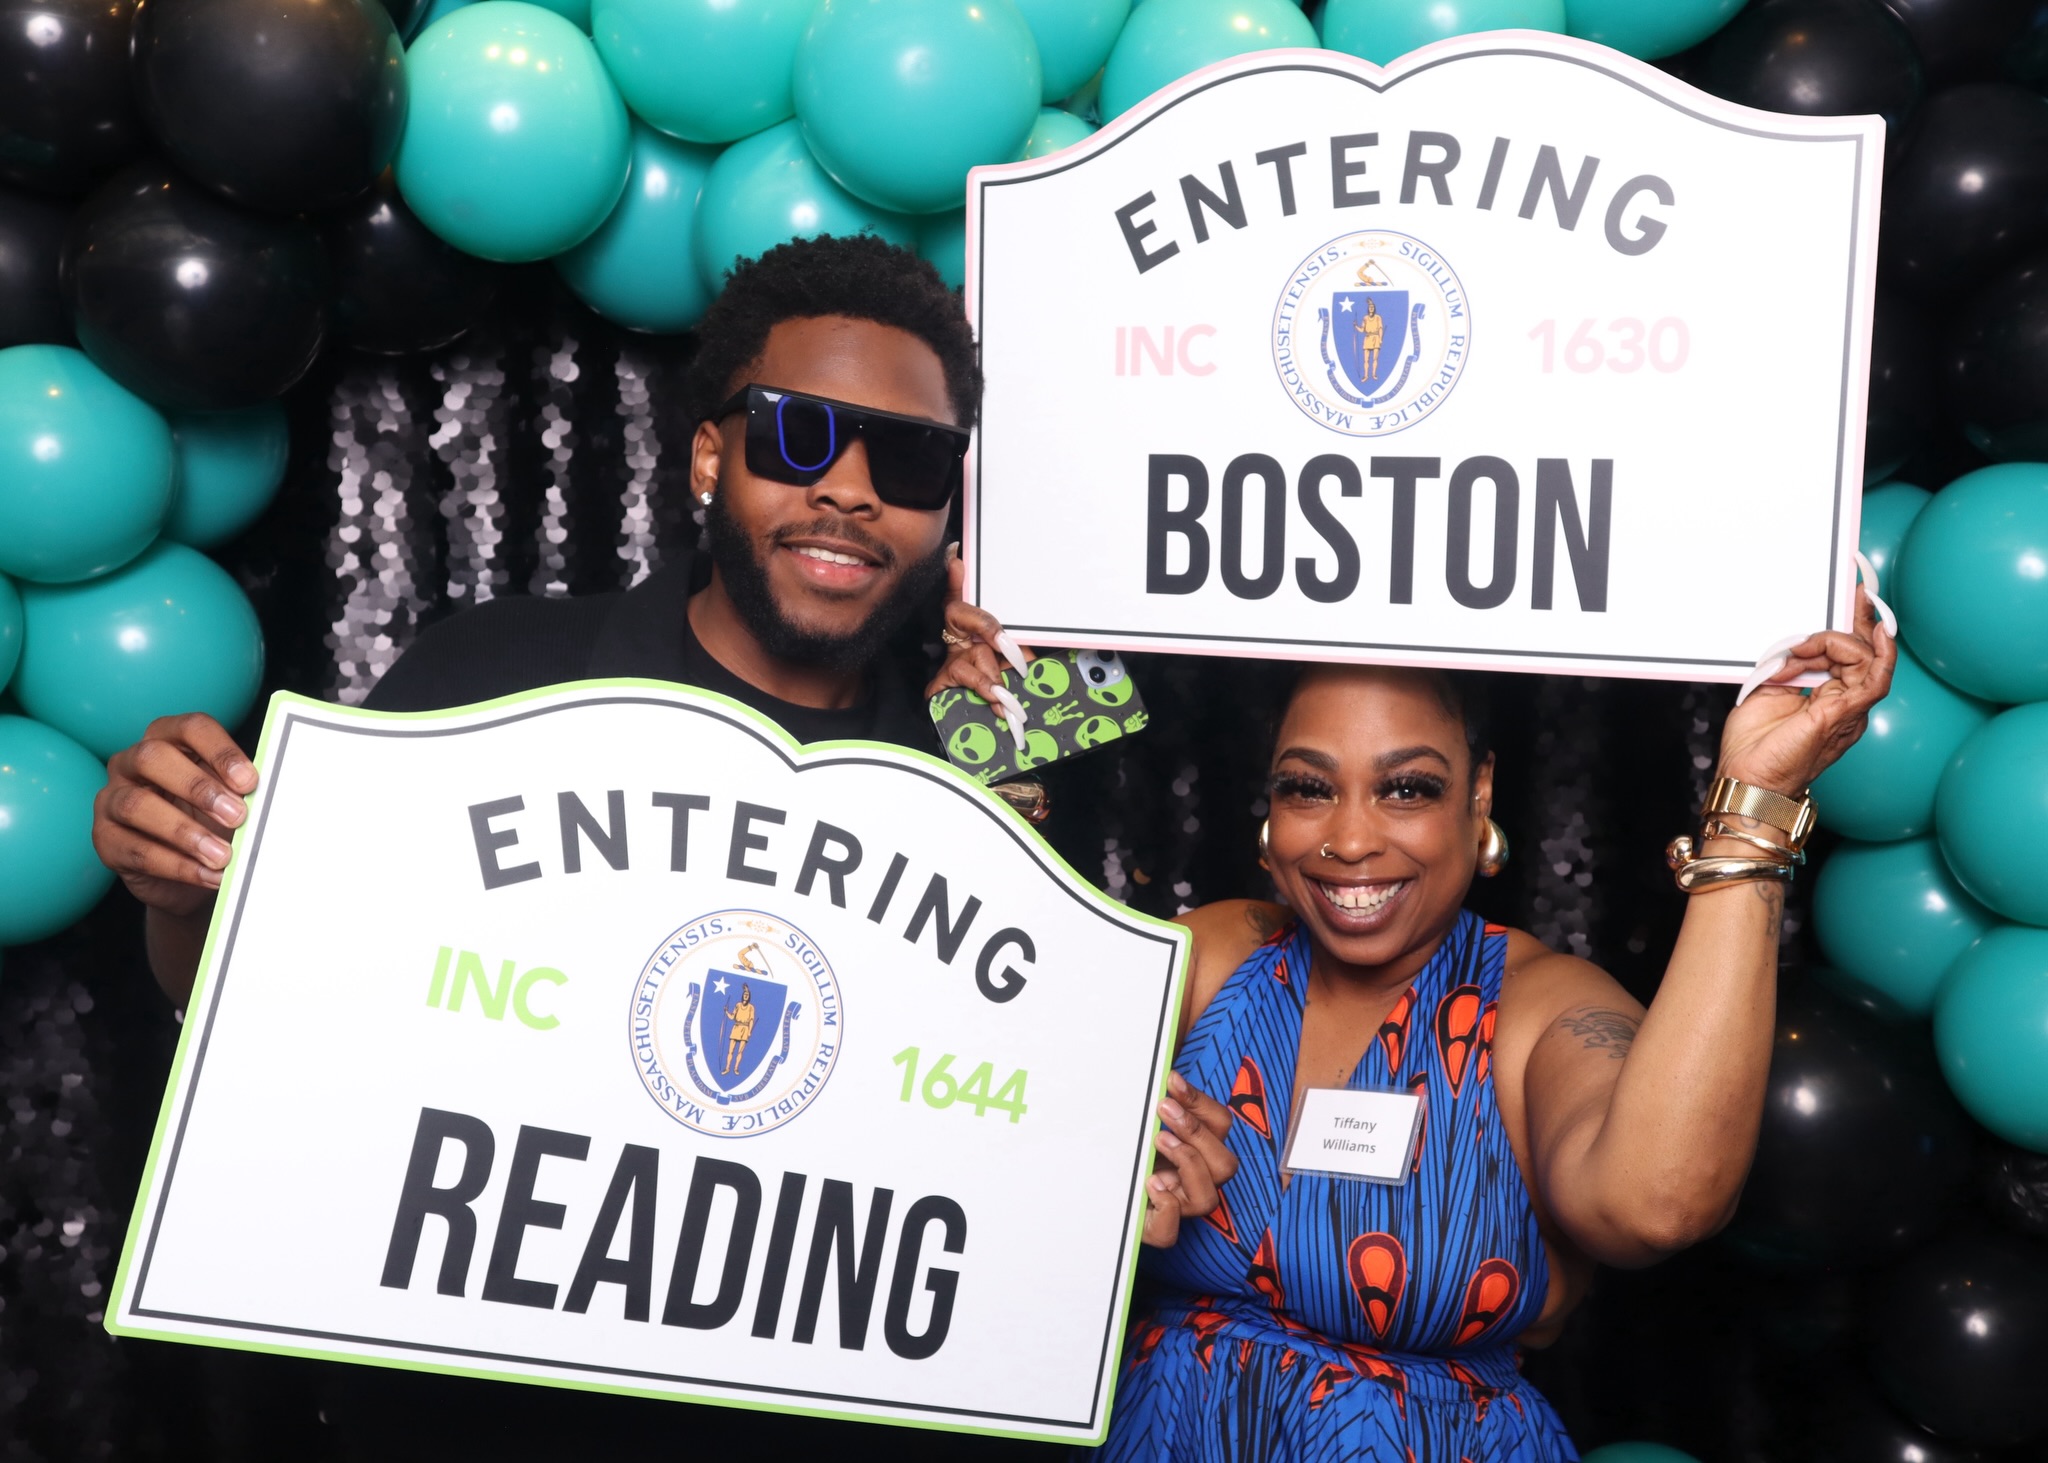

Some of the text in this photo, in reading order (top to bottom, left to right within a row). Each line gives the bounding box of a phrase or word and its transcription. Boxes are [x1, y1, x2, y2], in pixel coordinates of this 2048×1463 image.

[1115, 131, 1675, 274] ENTERING
[1398, 241, 1464, 318] SIGILLUM
[1116, 316, 1691, 377] INC 1630
[1147, 453, 1613, 612] BOSTON
[469, 791, 1036, 1004] ENTERING
[427, 947, 1030, 1125] INC 1644
[784, 933, 837, 1026] SIGILLUM
[1323, 1138, 1376, 1154] Williams
[1334, 1117, 1377, 1134] Tiffany
[380, 1107, 968, 1361] READING
